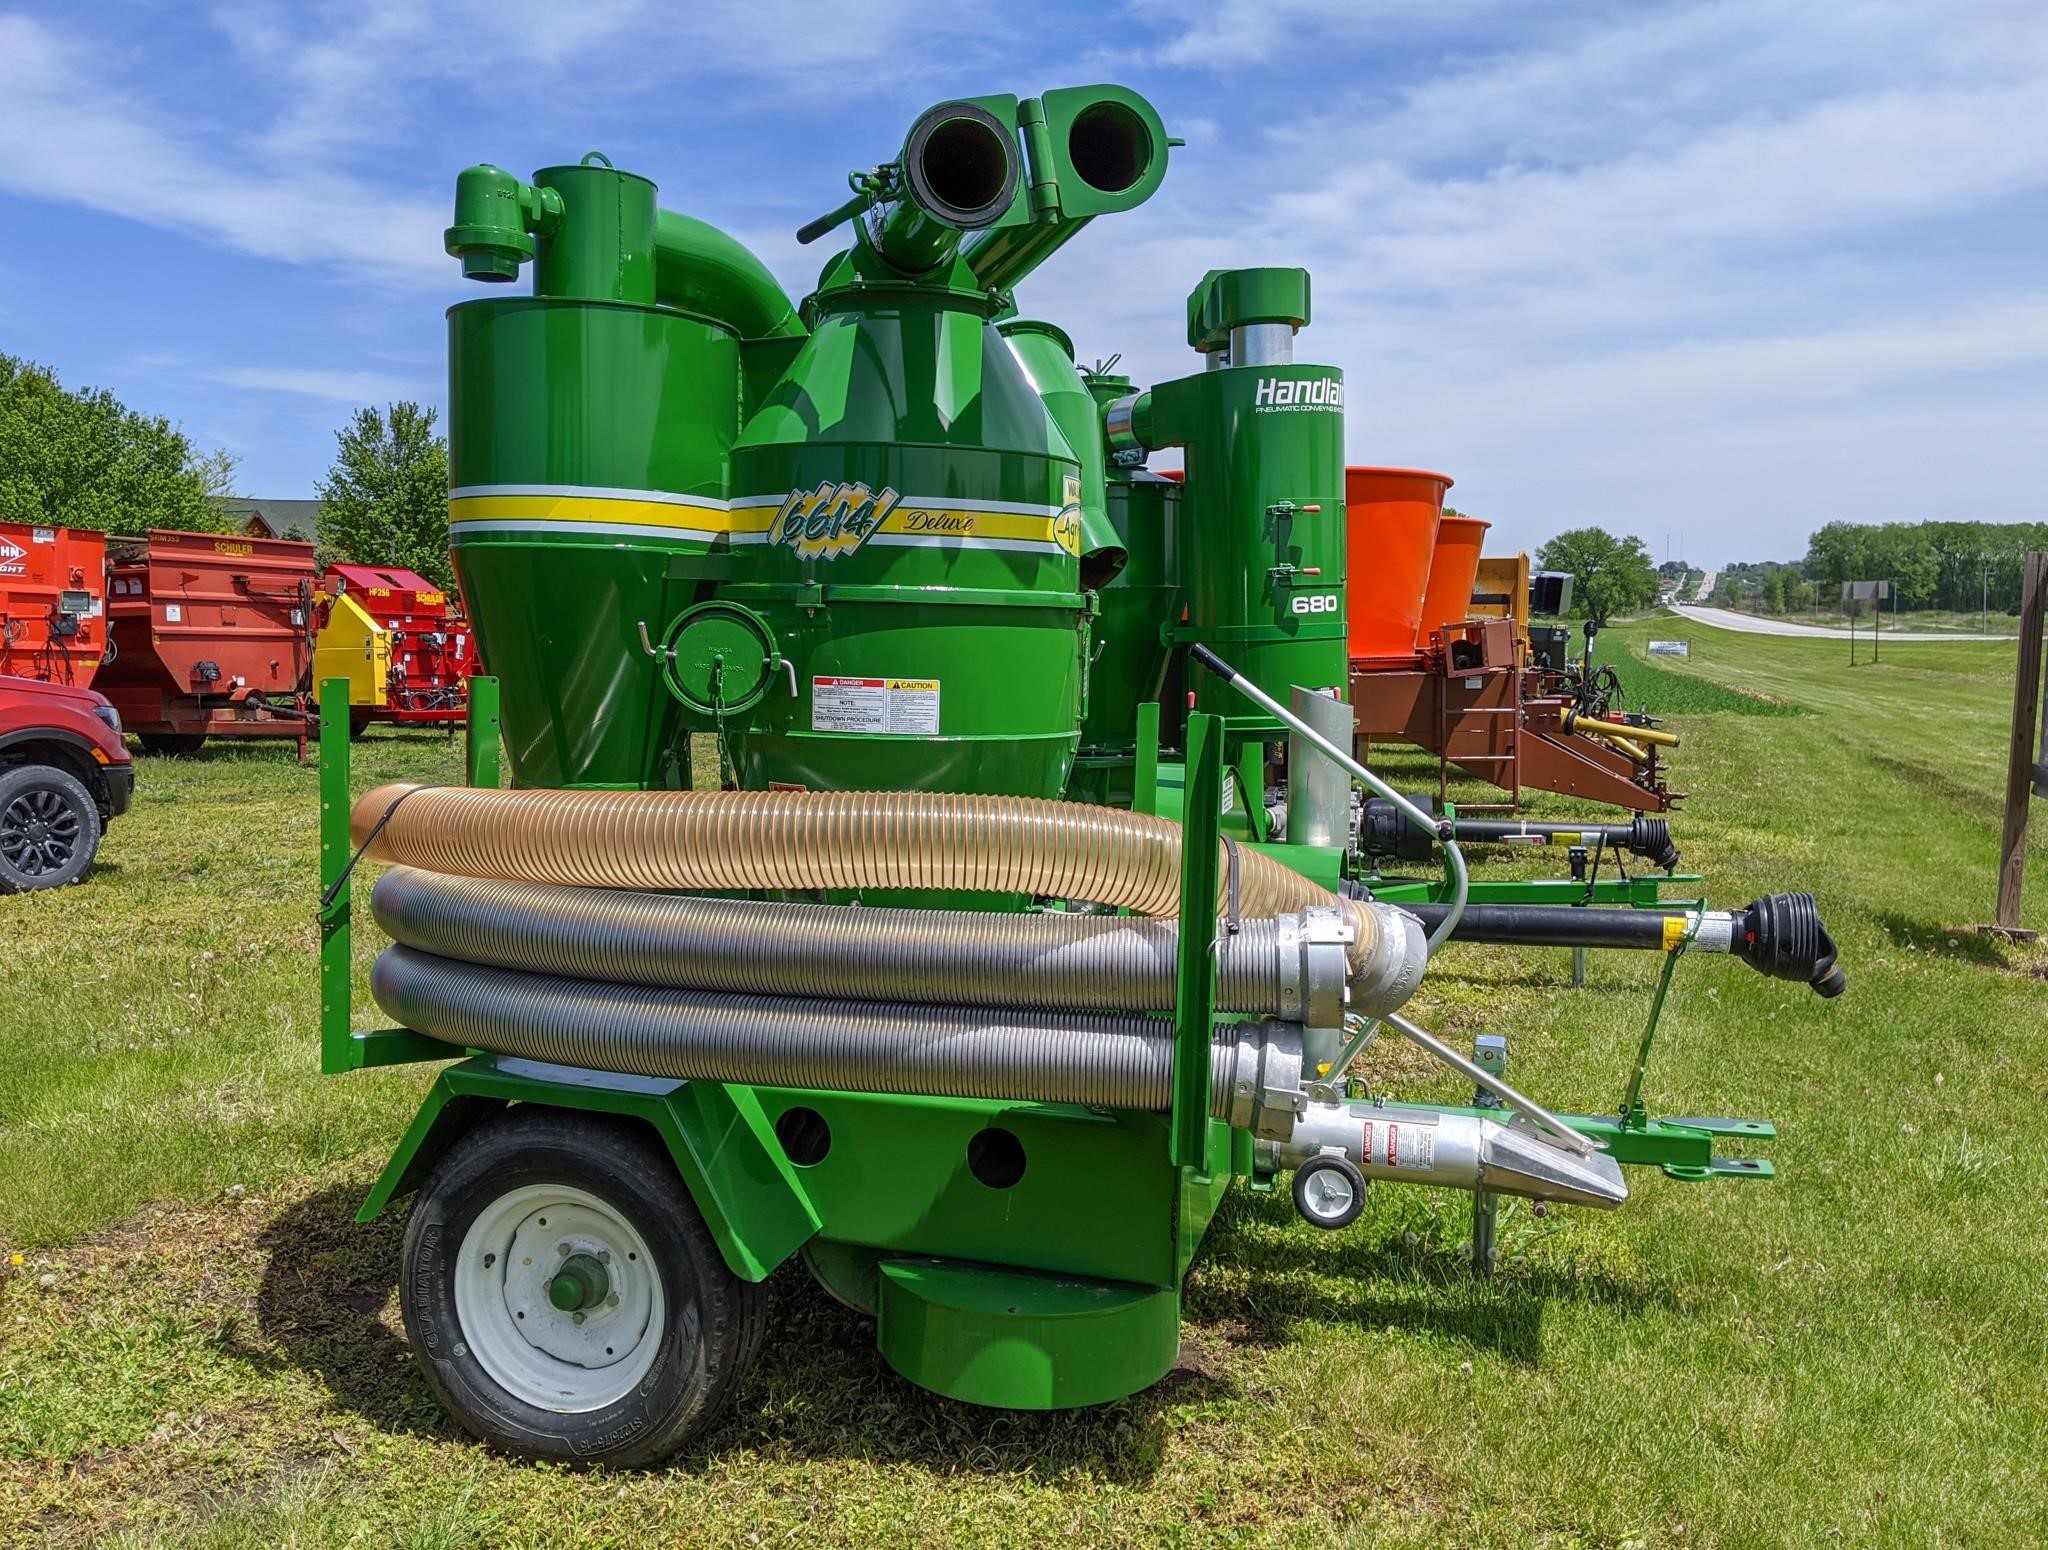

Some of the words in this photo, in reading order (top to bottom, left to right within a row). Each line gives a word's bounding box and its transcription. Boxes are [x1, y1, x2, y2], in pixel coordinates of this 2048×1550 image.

[1256, 405, 1300, 414] PNEUMATIC
[782, 499, 876, 540] 6614
[903, 510, 974, 533] Deluxe
[214, 542, 253, 554] SCHULER
[416, 593, 444, 604] SCHULER
[1292, 594, 1338, 614] 680
[901, 681, 933, 690] CAUTION
[1364, 1124, 1372, 1152] DANGER
[1389, 1127, 1397, 1155] DANGER
[417, 1232, 440, 1349] GLADIATOR
